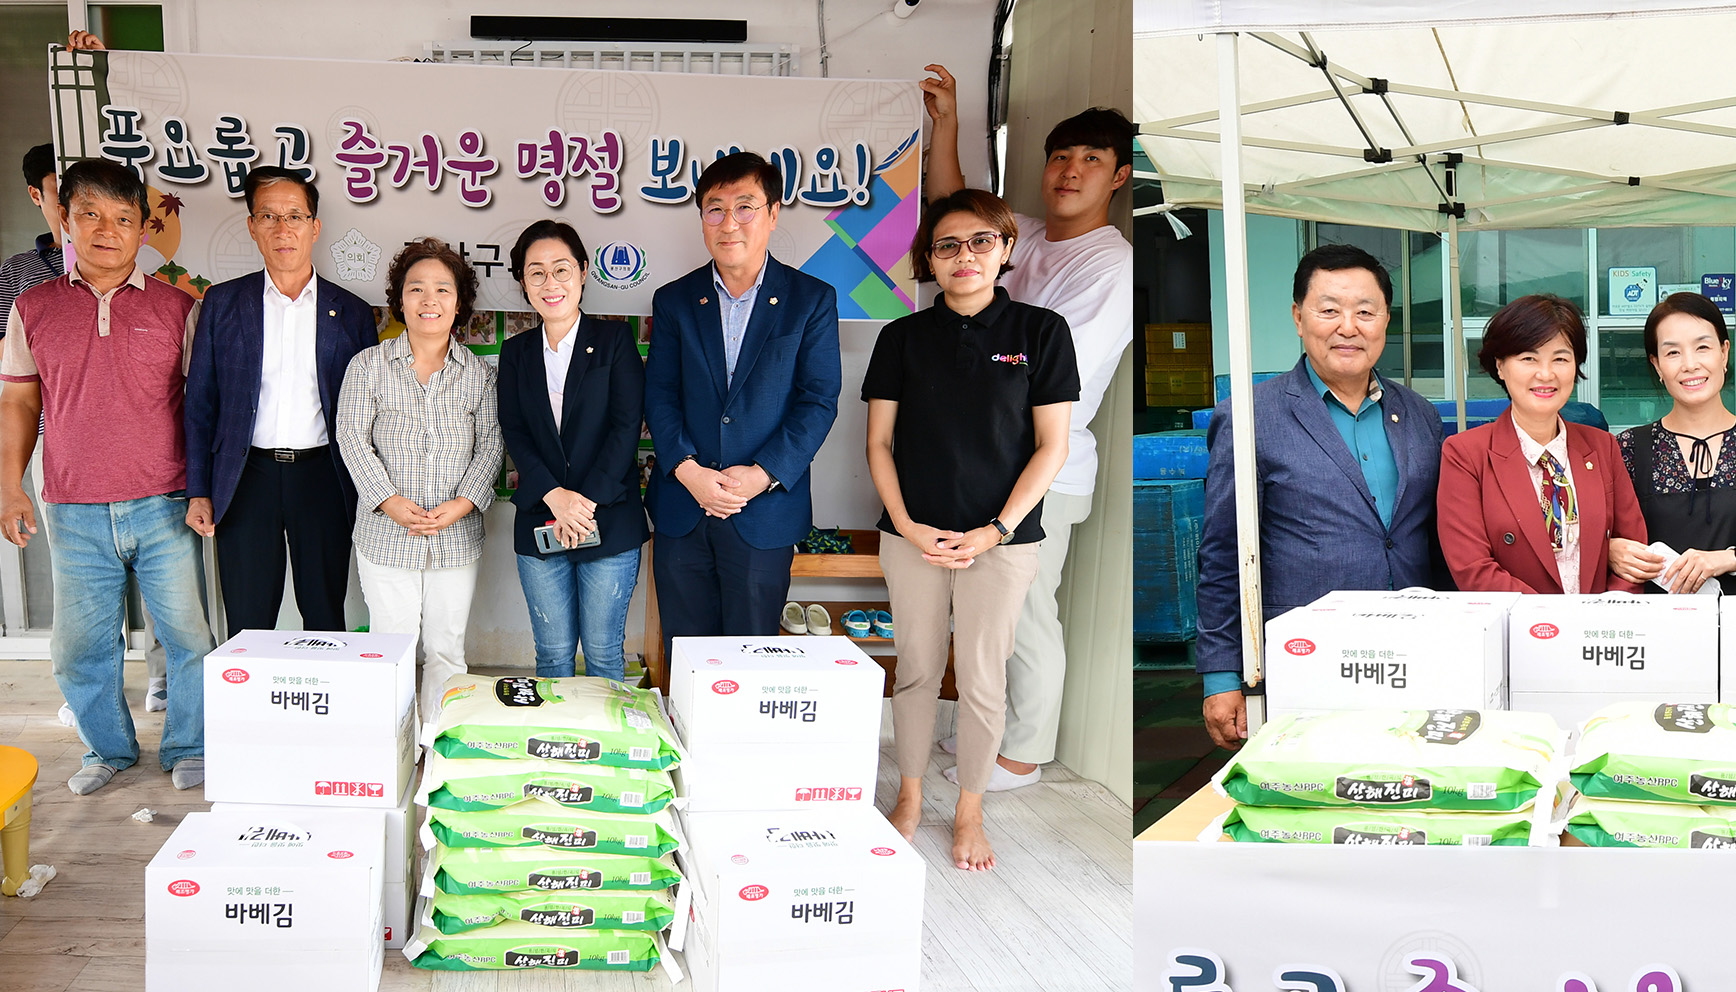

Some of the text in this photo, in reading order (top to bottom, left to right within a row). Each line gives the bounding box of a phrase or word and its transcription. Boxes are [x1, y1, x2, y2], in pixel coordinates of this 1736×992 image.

[100, 108, 873, 209] 풍요롭고 즐거운 명절 보요!
[1632, 270, 1652, 278] Safety
[991, 353, 1028, 365] deligh
[1619, 630, 1634, 639] 더한
[1379, 650, 1394, 659] 더한
[1582, 645, 1645, 670] 바베김
[1340, 662, 1407, 689] 바베김
[271, 691, 330, 715] 바베김
[759, 700, 817, 722] 바베김
[536, 742, 591, 760] 산해진미
[1347, 782, 1419, 801] 산해진미
[1260, 829, 1322, 841] 여주농산RPC
[1614, 831, 1679, 845] 여주농산RPC
[537, 876, 592, 890] 산해진미
[225, 903, 293, 928] 바베김
[530, 911, 585, 926] 산해진미
[791, 900, 854, 925] 바베김
[514, 953, 569, 967] 산해진미
